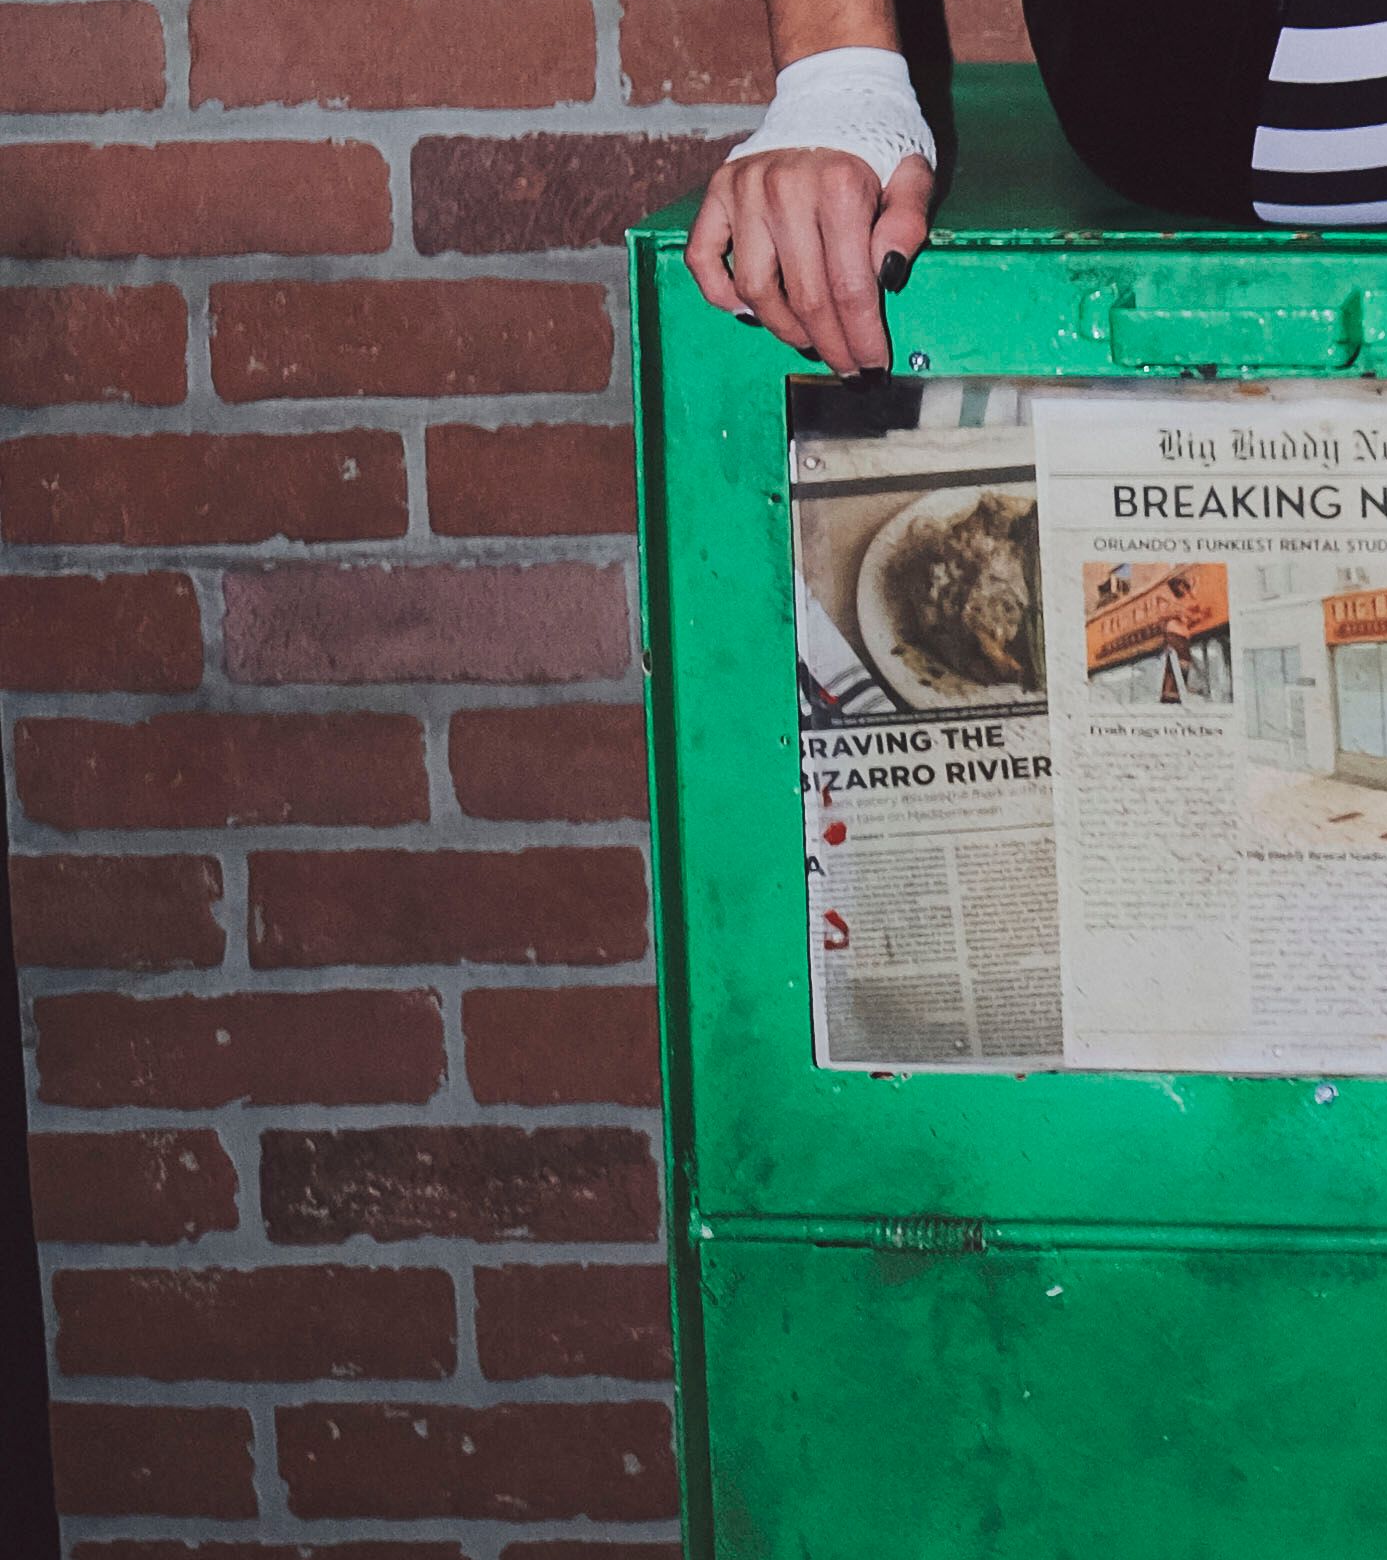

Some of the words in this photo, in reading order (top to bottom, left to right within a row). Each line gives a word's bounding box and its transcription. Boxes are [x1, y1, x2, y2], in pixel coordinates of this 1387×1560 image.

[1157, 427, 1218, 467] Big
[1231, 426, 1341, 470] Buddy
[1113, 484, 1343, 520] BREAKING
[1093, 536, 1191, 553] ORLANDO'S
[1197, 537, 1274, 553] FUNKIEST
[1279, 537, 1341, 554] RENTAL
[941, 725, 1006, 751] THE
